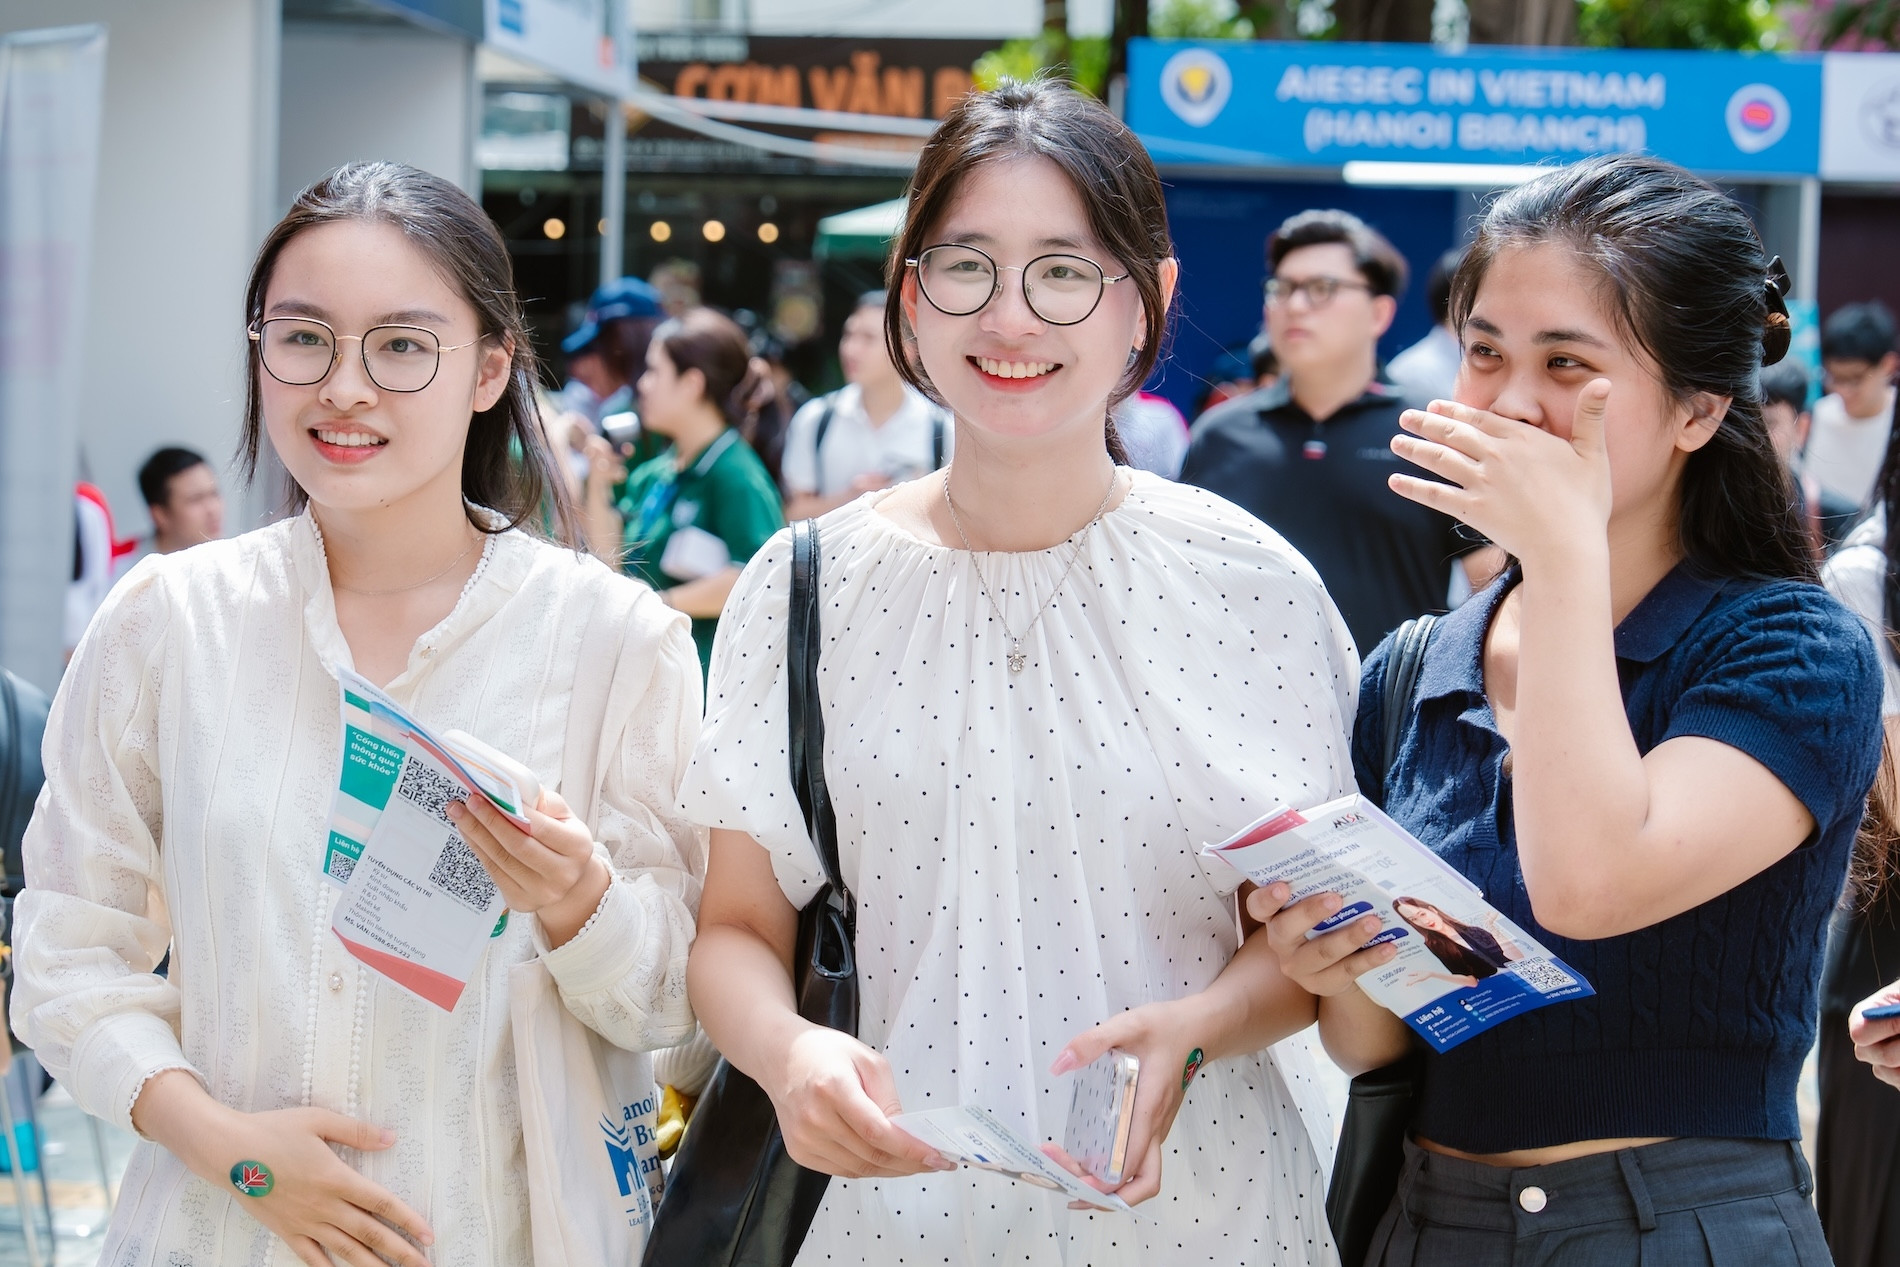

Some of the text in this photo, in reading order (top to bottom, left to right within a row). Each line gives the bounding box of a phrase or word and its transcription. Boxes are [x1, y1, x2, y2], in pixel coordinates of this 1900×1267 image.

[1277, 65, 1666, 110] AIESEC IN VIETNAM
[1304, 109, 1646, 153] (HANOI BRANCH)
[378, 756, 395, 767] qua
[1333, 812, 1364, 829] MISA
[403, 876, 416, 889] CÁC
[623, 1091, 656, 1121] anoi
